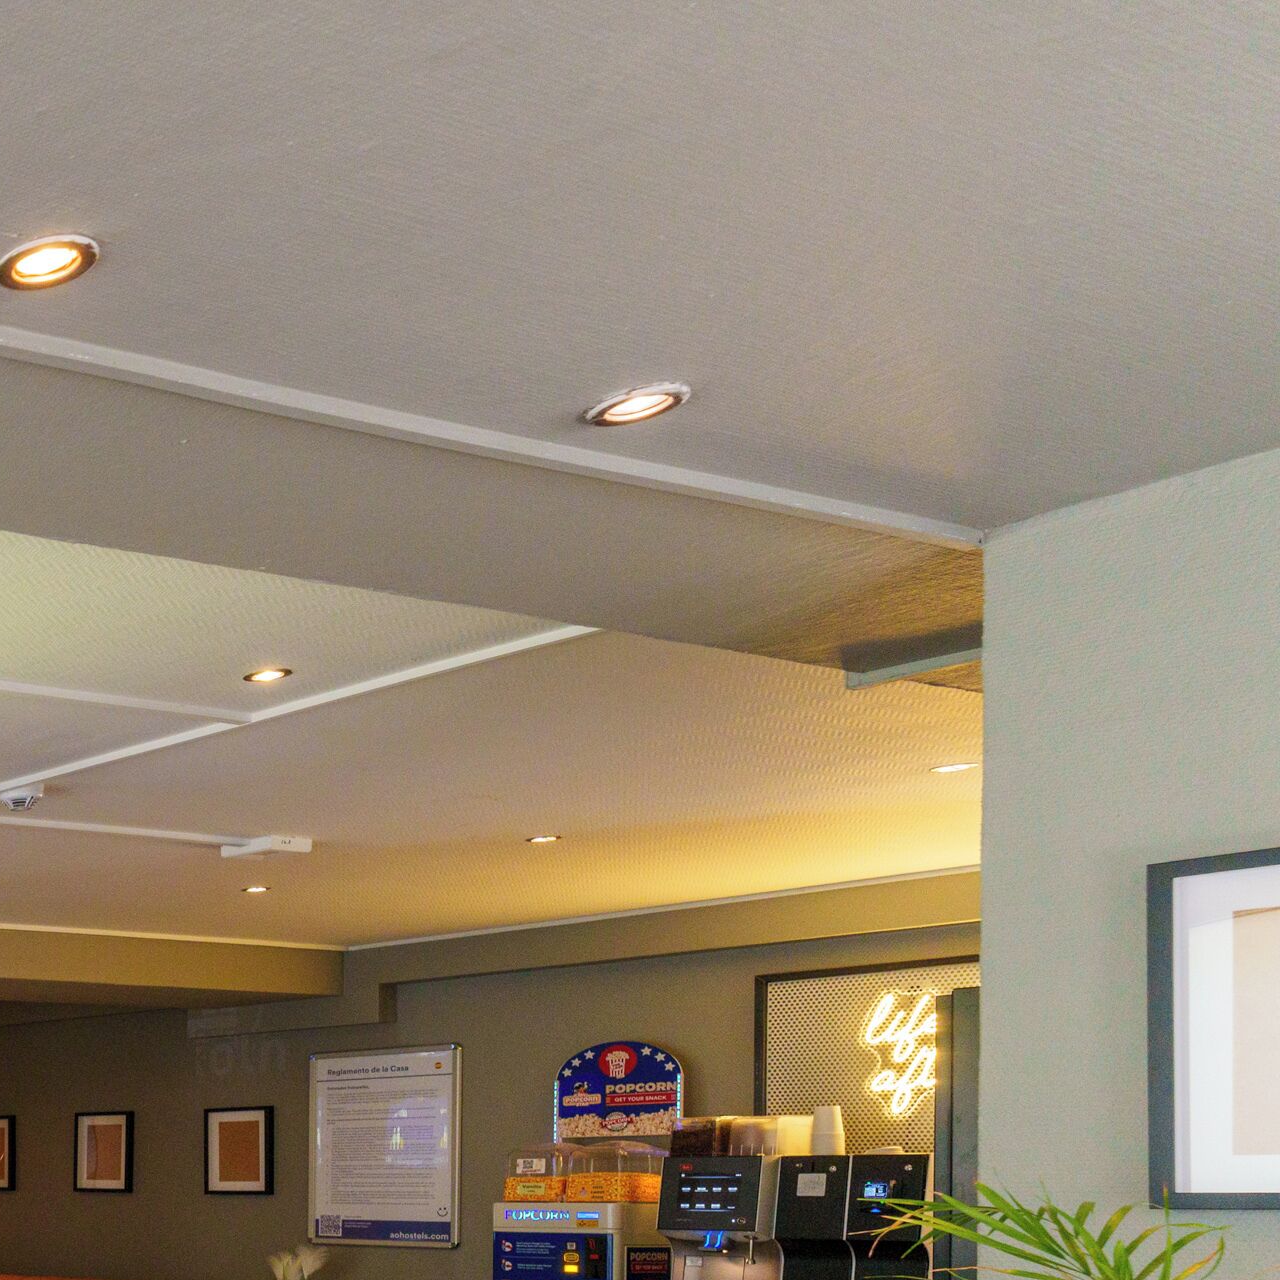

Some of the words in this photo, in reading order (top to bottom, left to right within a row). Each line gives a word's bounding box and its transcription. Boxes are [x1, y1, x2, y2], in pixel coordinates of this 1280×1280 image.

[327, 1067, 369, 1076] Reglamento
[371, 1066, 380, 1074] de
[605, 1081, 676, 1094] POPCORN
[505, 1209, 570, 1221] POPCORN
[390, 1231, 449, 1241] aohostels.com
[630, 1252, 668, 1261] POPCORN
